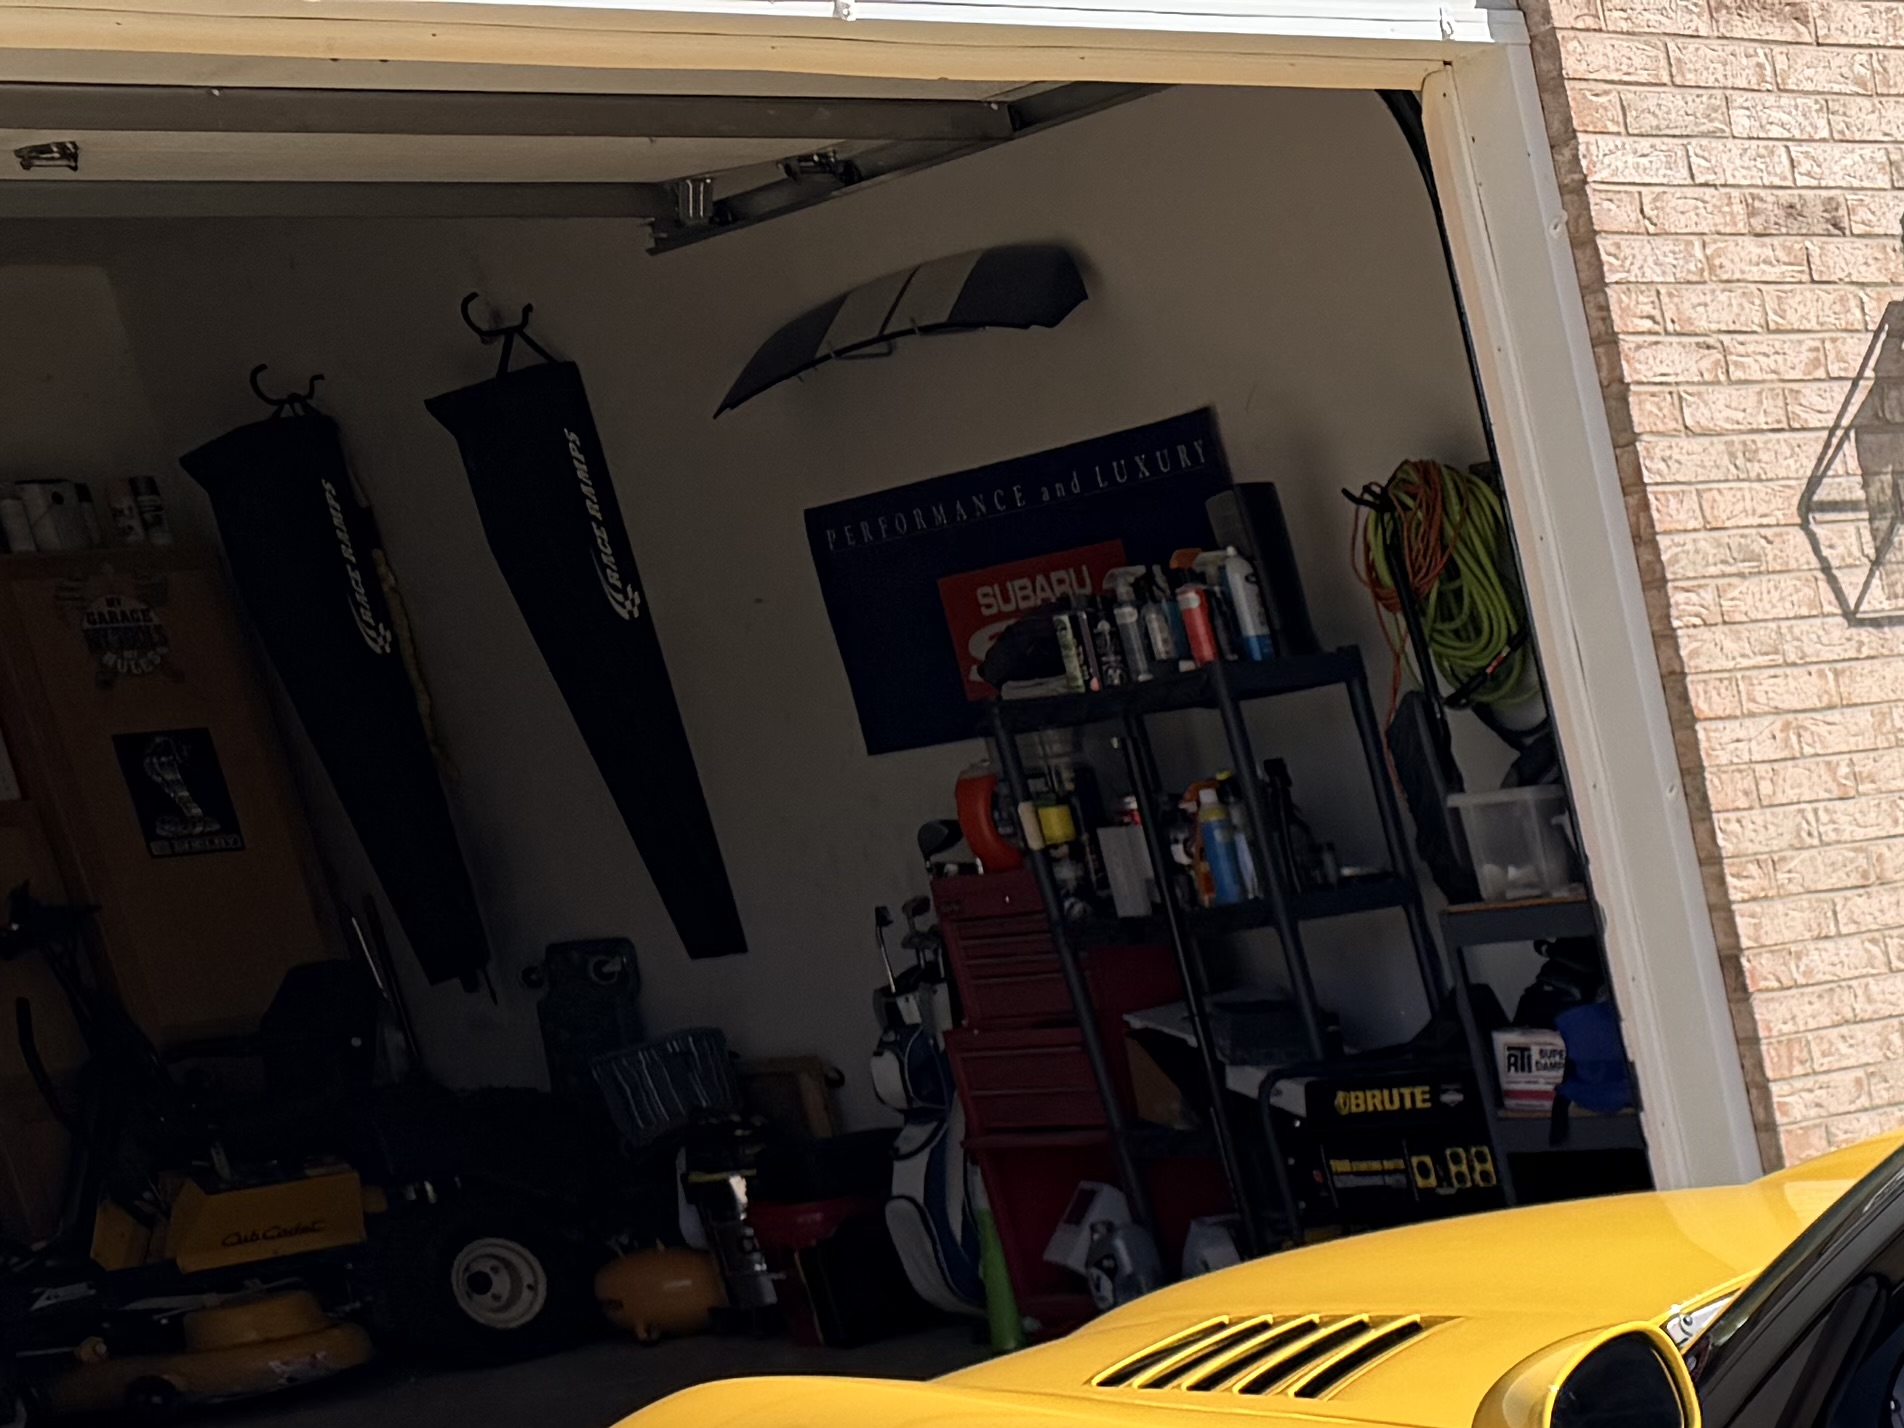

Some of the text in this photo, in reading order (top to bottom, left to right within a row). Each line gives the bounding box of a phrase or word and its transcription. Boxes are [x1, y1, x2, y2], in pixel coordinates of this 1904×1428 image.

[564, 427, 622, 588] RACE RAMPS
[826, 439, 1208, 552] PERFORMANCE and LUXURY
[976, 564, 1094, 618] SUBARU
[1538, 1048, 1567, 1060] SUPE
[1351, 1084, 1433, 1115] BRUTE
[221, 1218, 327, 1247] Cub Cadet
